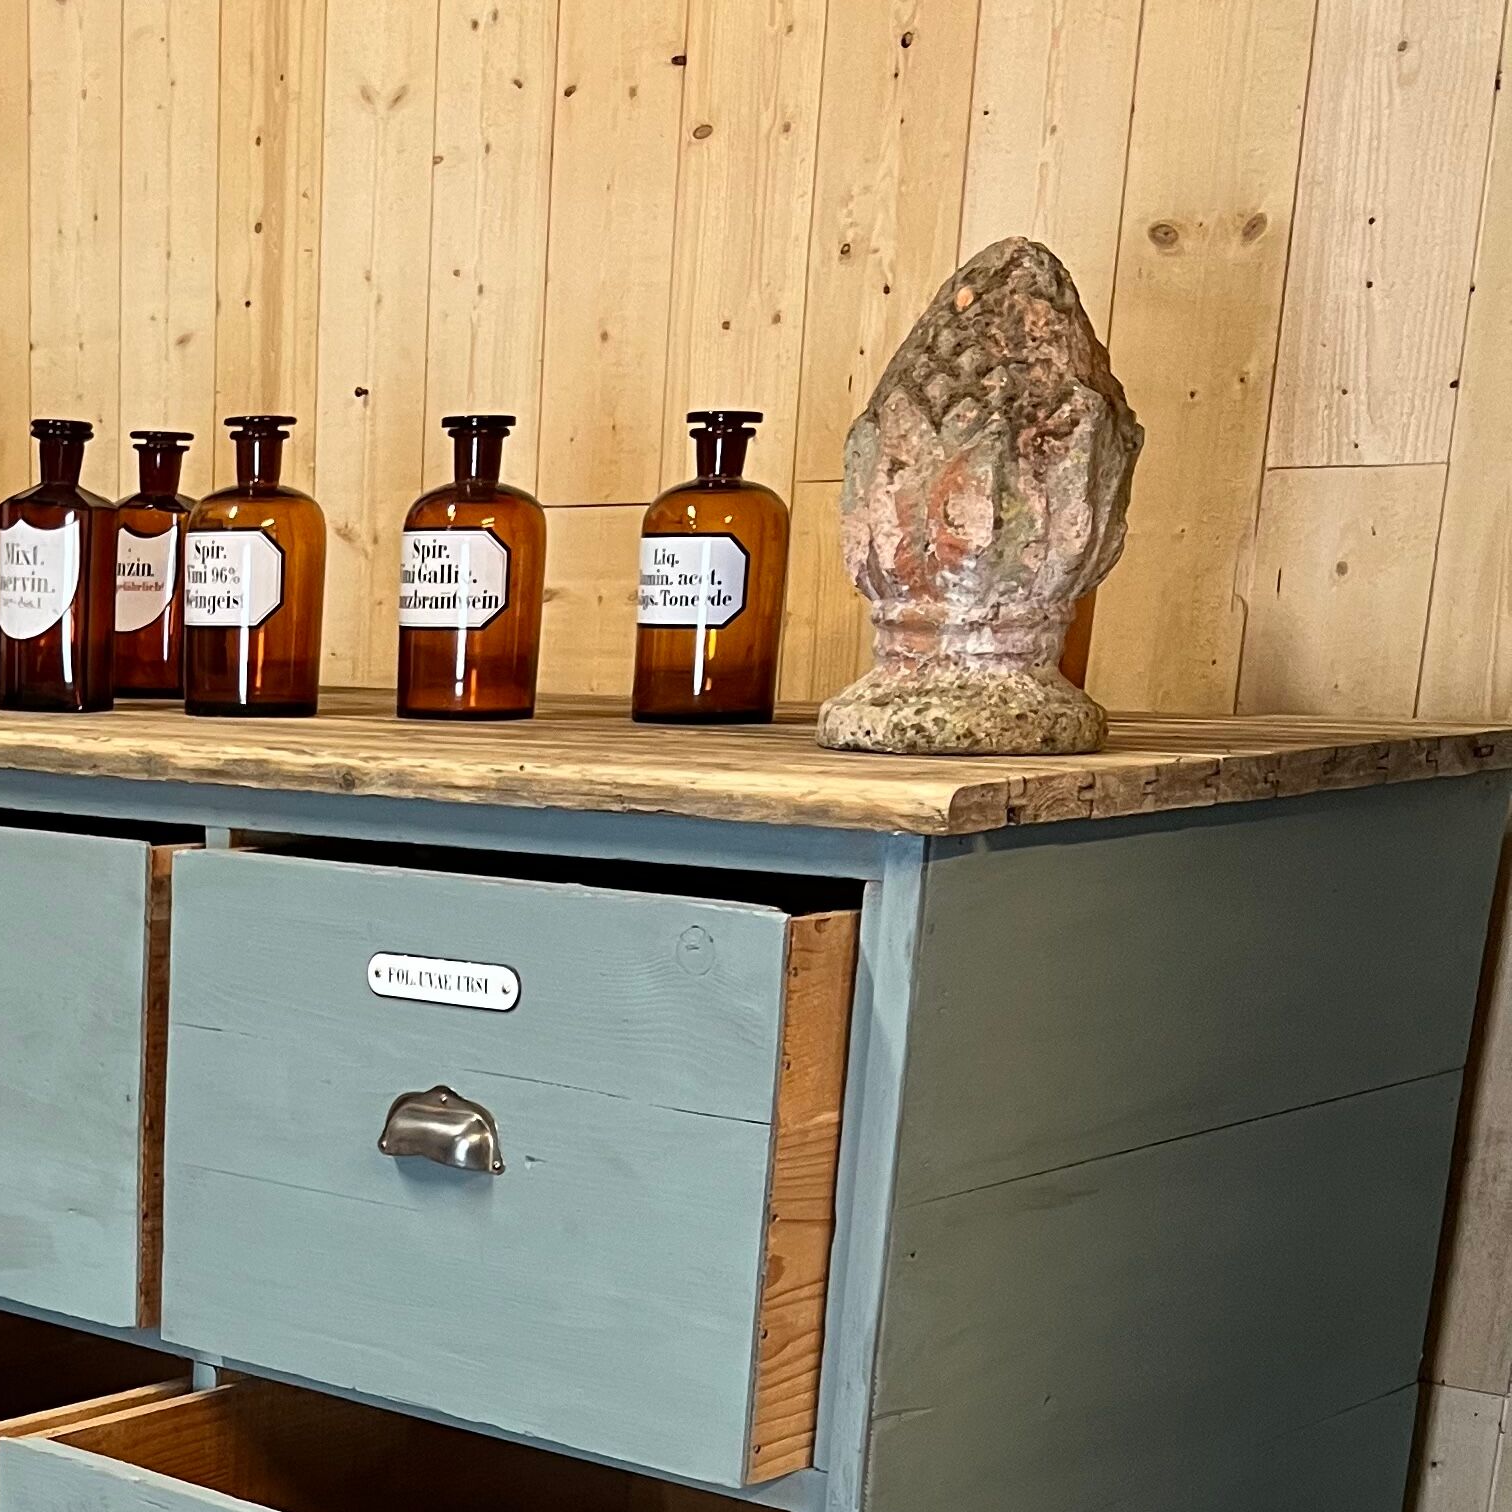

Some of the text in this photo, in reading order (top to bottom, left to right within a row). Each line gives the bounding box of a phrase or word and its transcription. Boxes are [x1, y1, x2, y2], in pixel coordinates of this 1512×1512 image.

[194, 540, 227, 565] Spir.
[413, 538, 450, 564] Spir.
[654, 548, 680, 568] Liq.
[211, 566, 241, 585] 96%
[418, 563, 477, 584] Galli.
[678, 568, 723, 586] act.
[660, 589, 733, 607] Tonede
[388, 966, 417, 986] FOL.
